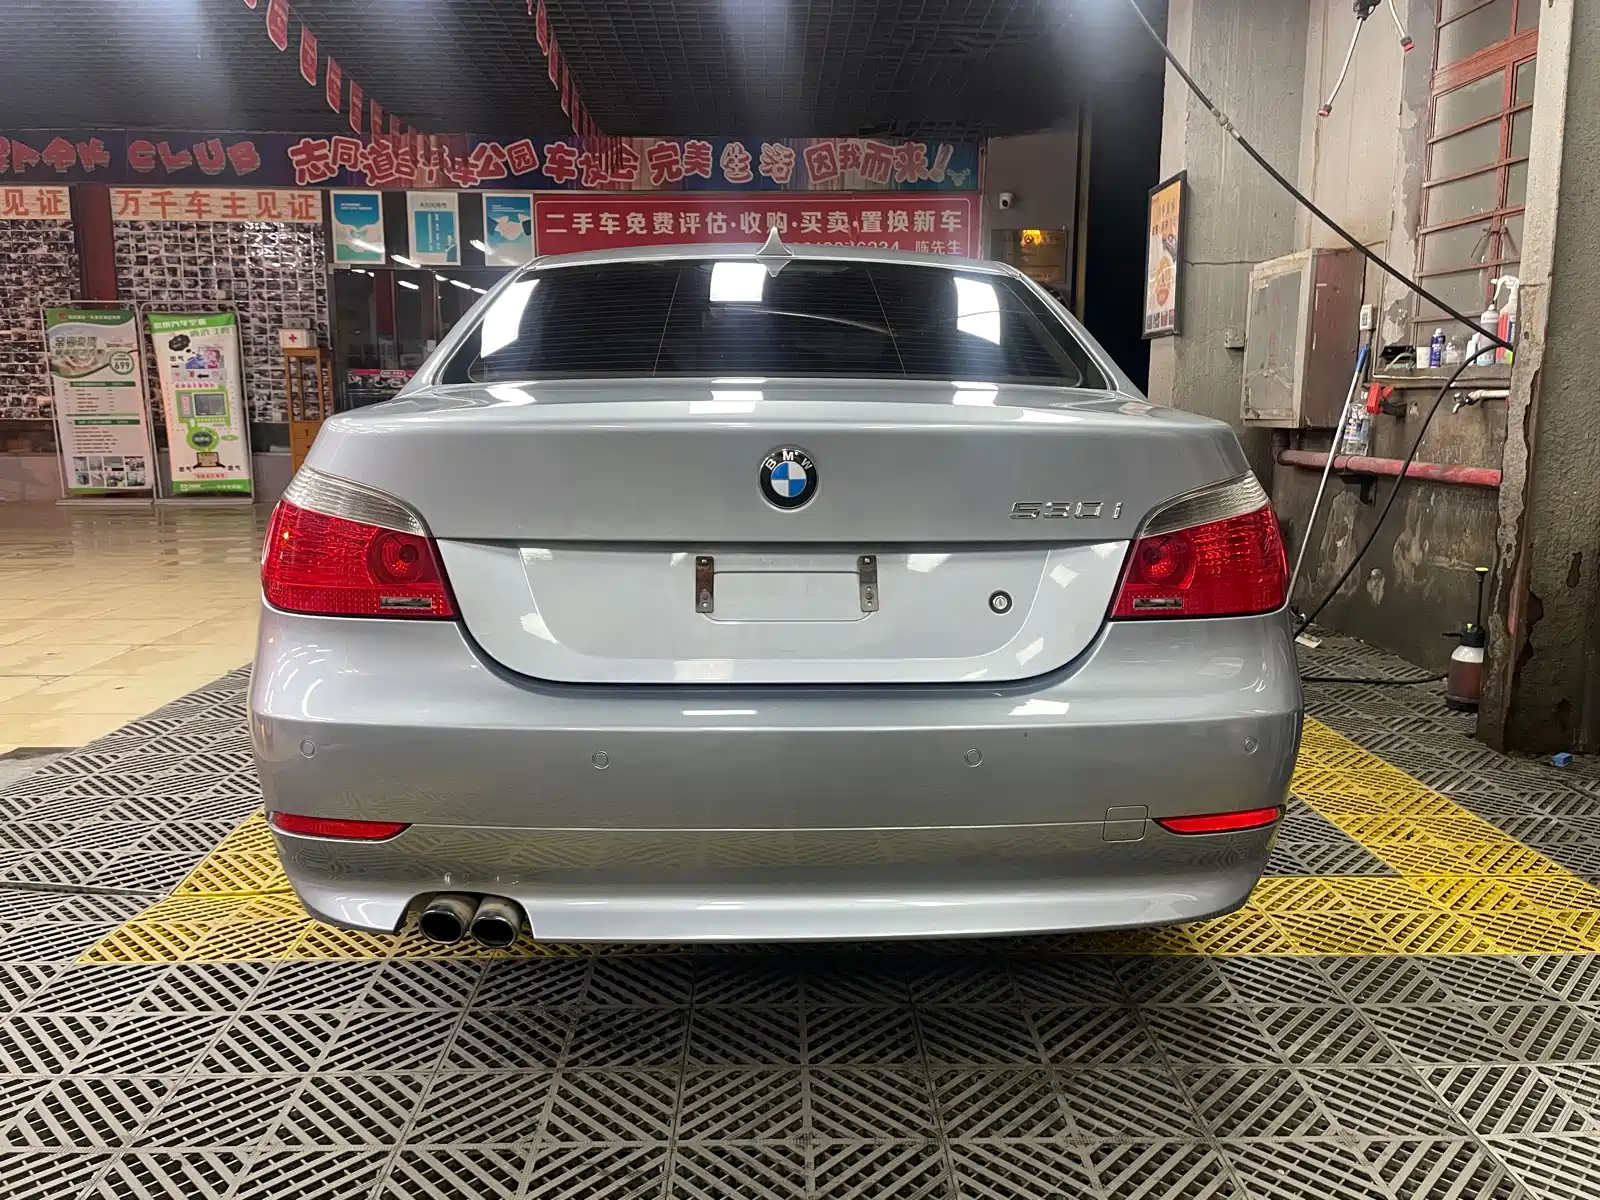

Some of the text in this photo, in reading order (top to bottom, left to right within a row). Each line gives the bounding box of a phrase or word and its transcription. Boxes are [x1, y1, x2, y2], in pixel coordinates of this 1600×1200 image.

[128, 137, 260, 175] CLUB
[2, 188, 65, 216] 见证
[115, 189, 317, 220] 万千车主见证
[915, 240, 962, 255] 陈先生
[114, 361, 130, 370] 699
[764, 449, 813, 471] BMW
